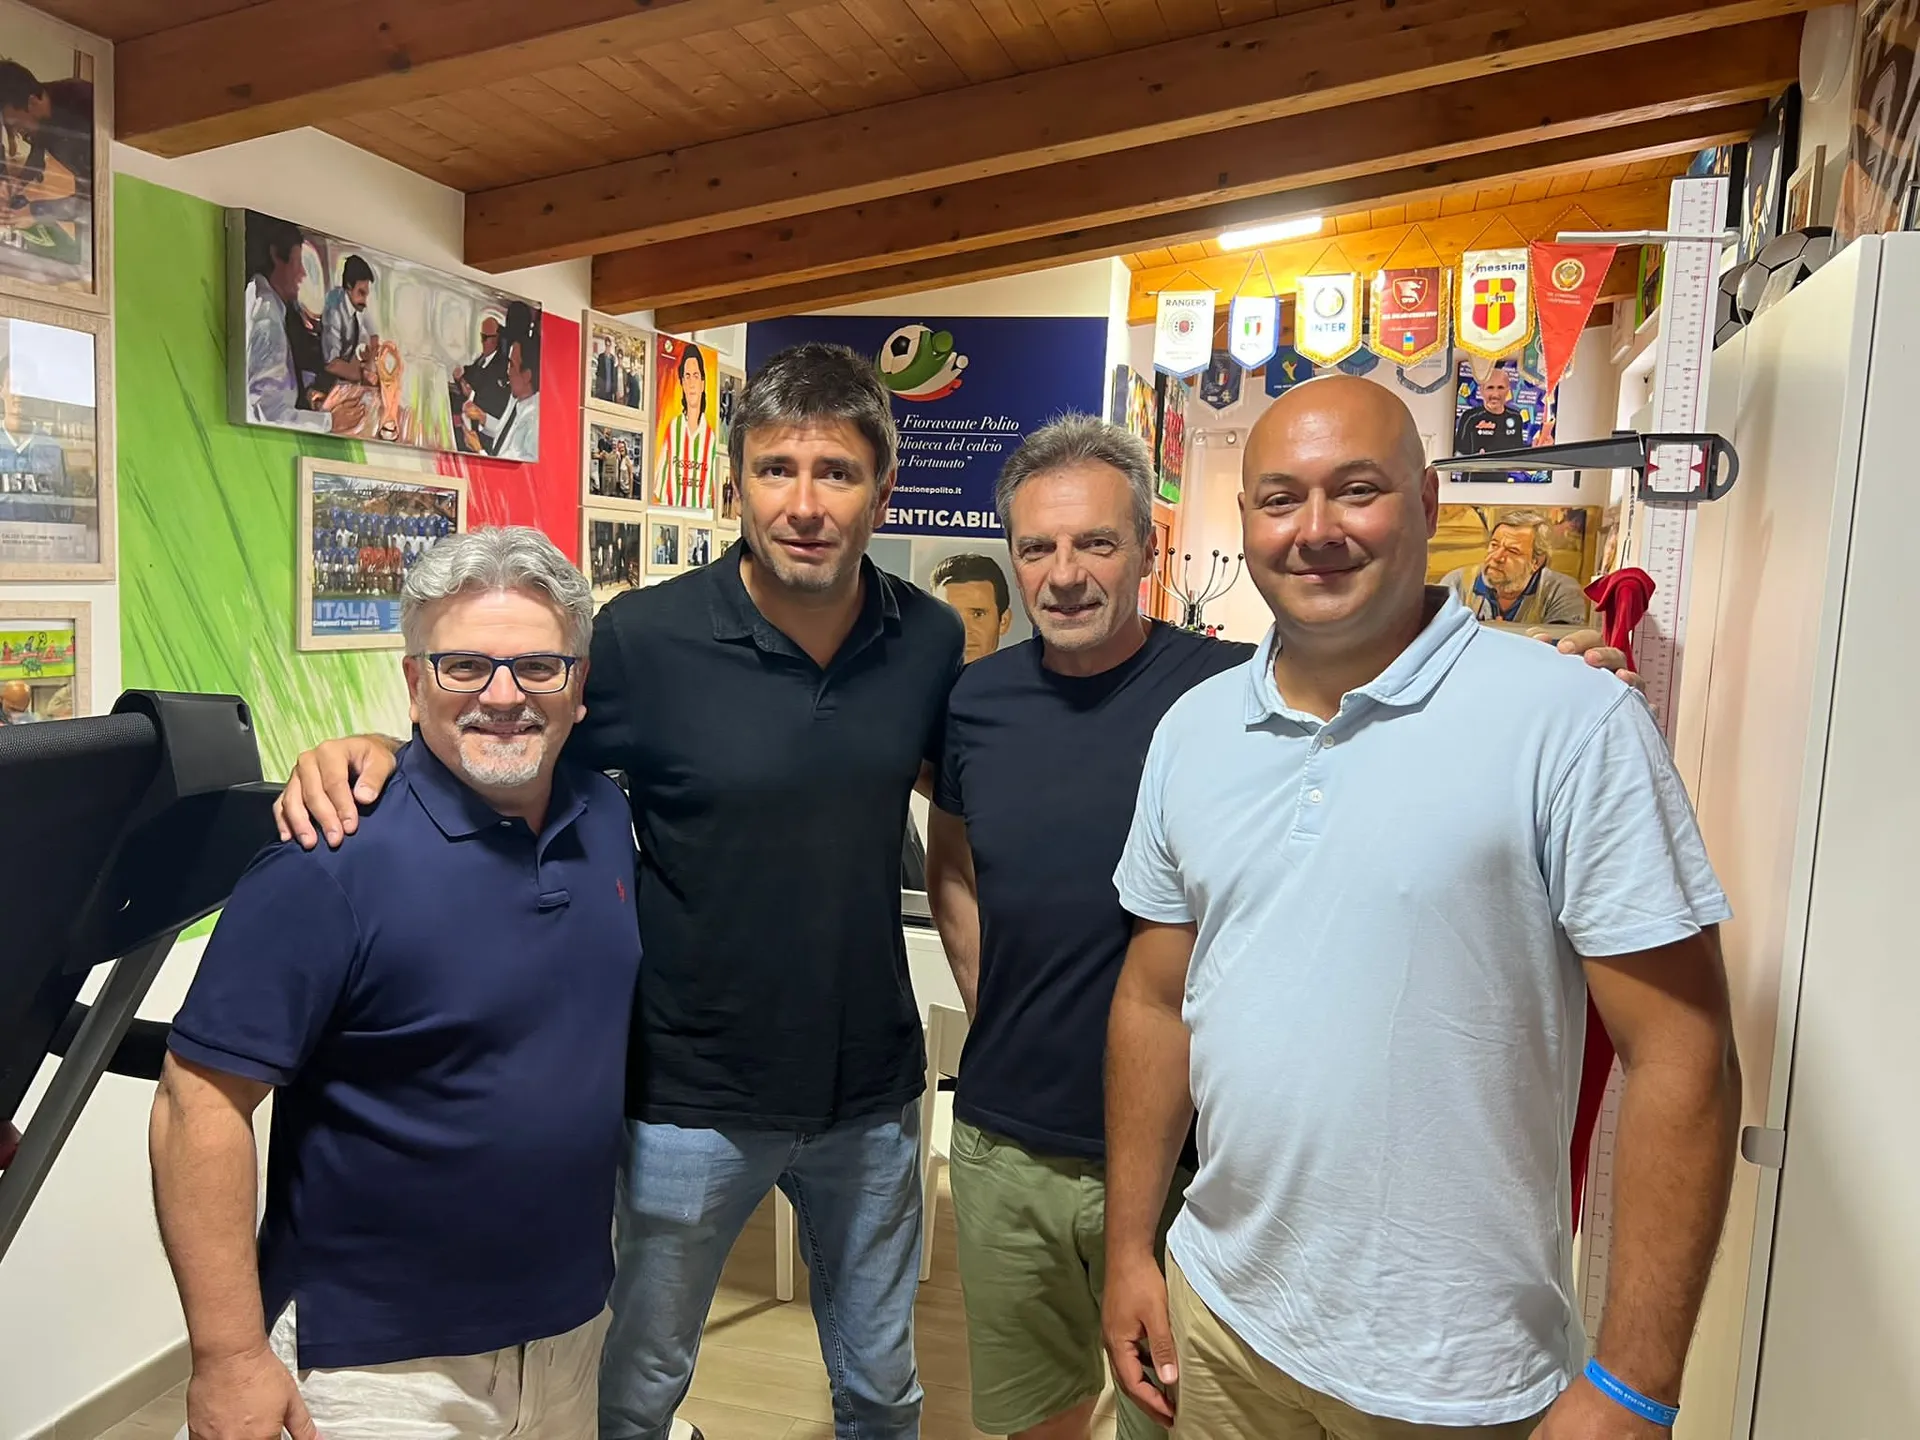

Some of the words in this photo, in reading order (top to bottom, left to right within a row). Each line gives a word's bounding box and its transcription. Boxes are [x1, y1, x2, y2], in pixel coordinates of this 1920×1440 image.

[1165, 299, 1207, 307] RANGERS
[1311, 322, 1346, 332] INTER
[903, 413, 978, 430] Fioravante
[980, 415, 1020, 431] Polito
[945, 437, 963, 452] del
[966, 438, 1003, 452] calcio
[316, 602, 379, 619] ITALIA
